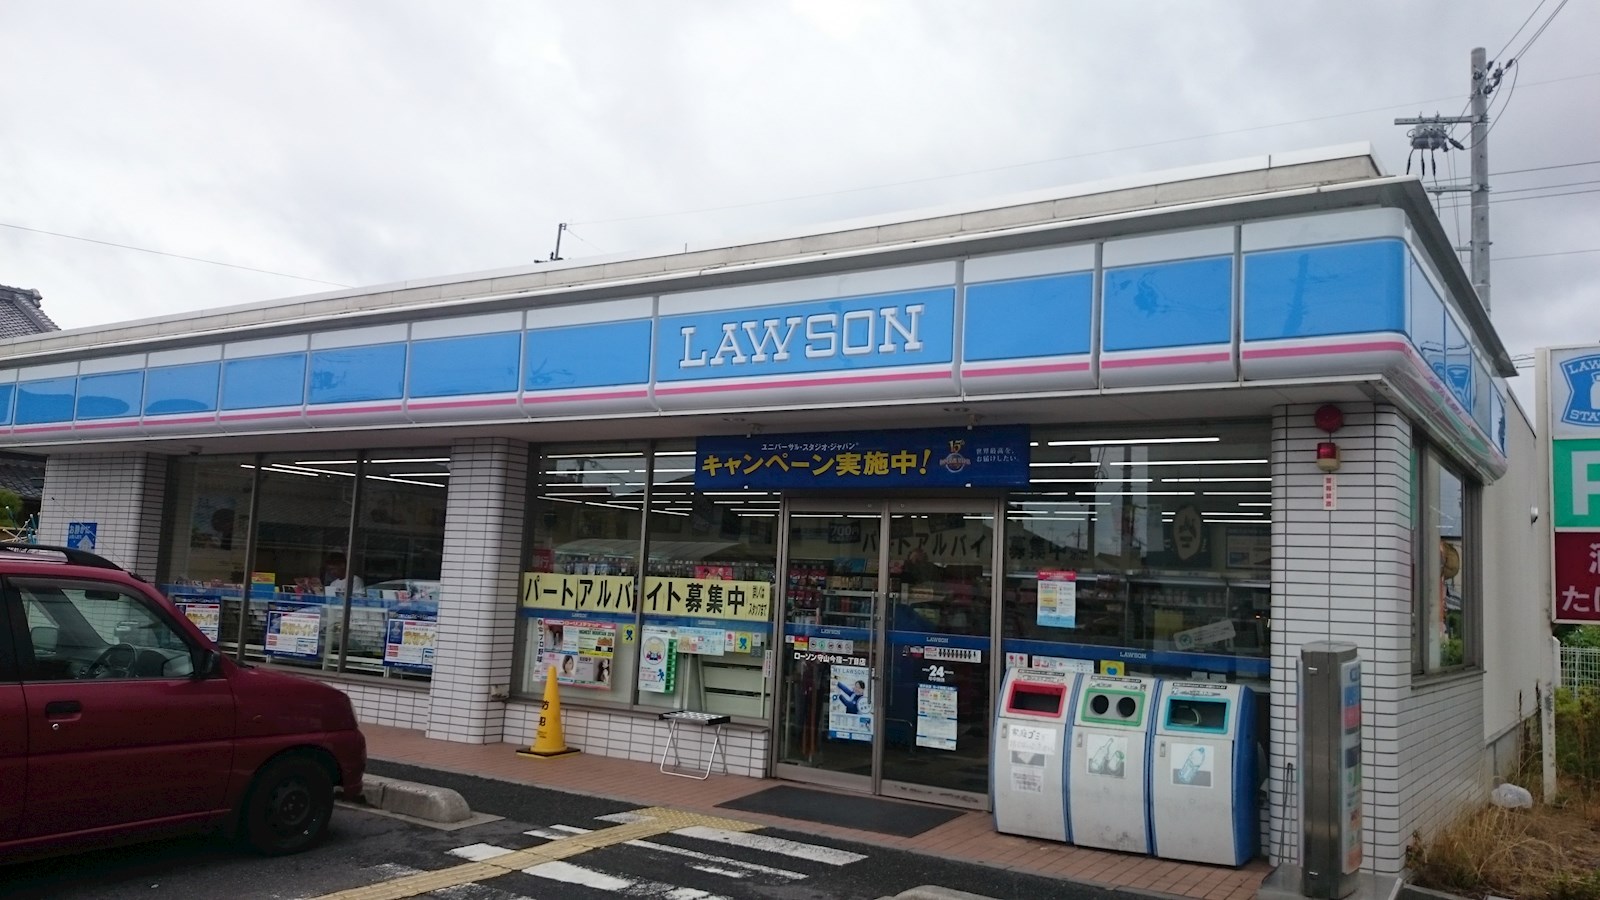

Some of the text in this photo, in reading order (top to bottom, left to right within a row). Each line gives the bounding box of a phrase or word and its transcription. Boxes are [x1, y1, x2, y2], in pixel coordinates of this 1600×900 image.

[679, 303, 925, 369] LAWSON
[702, 448, 932, 477] キャンペーン実施中!
[524, 578, 746, 616] パートアルバイト募集中
[1562, 586, 1600, 611] た
[926, 636, 949, 644] LAWSON
[1119, 651, 1147, 659] LAWSON
[929, 664, 945, 678] 24
